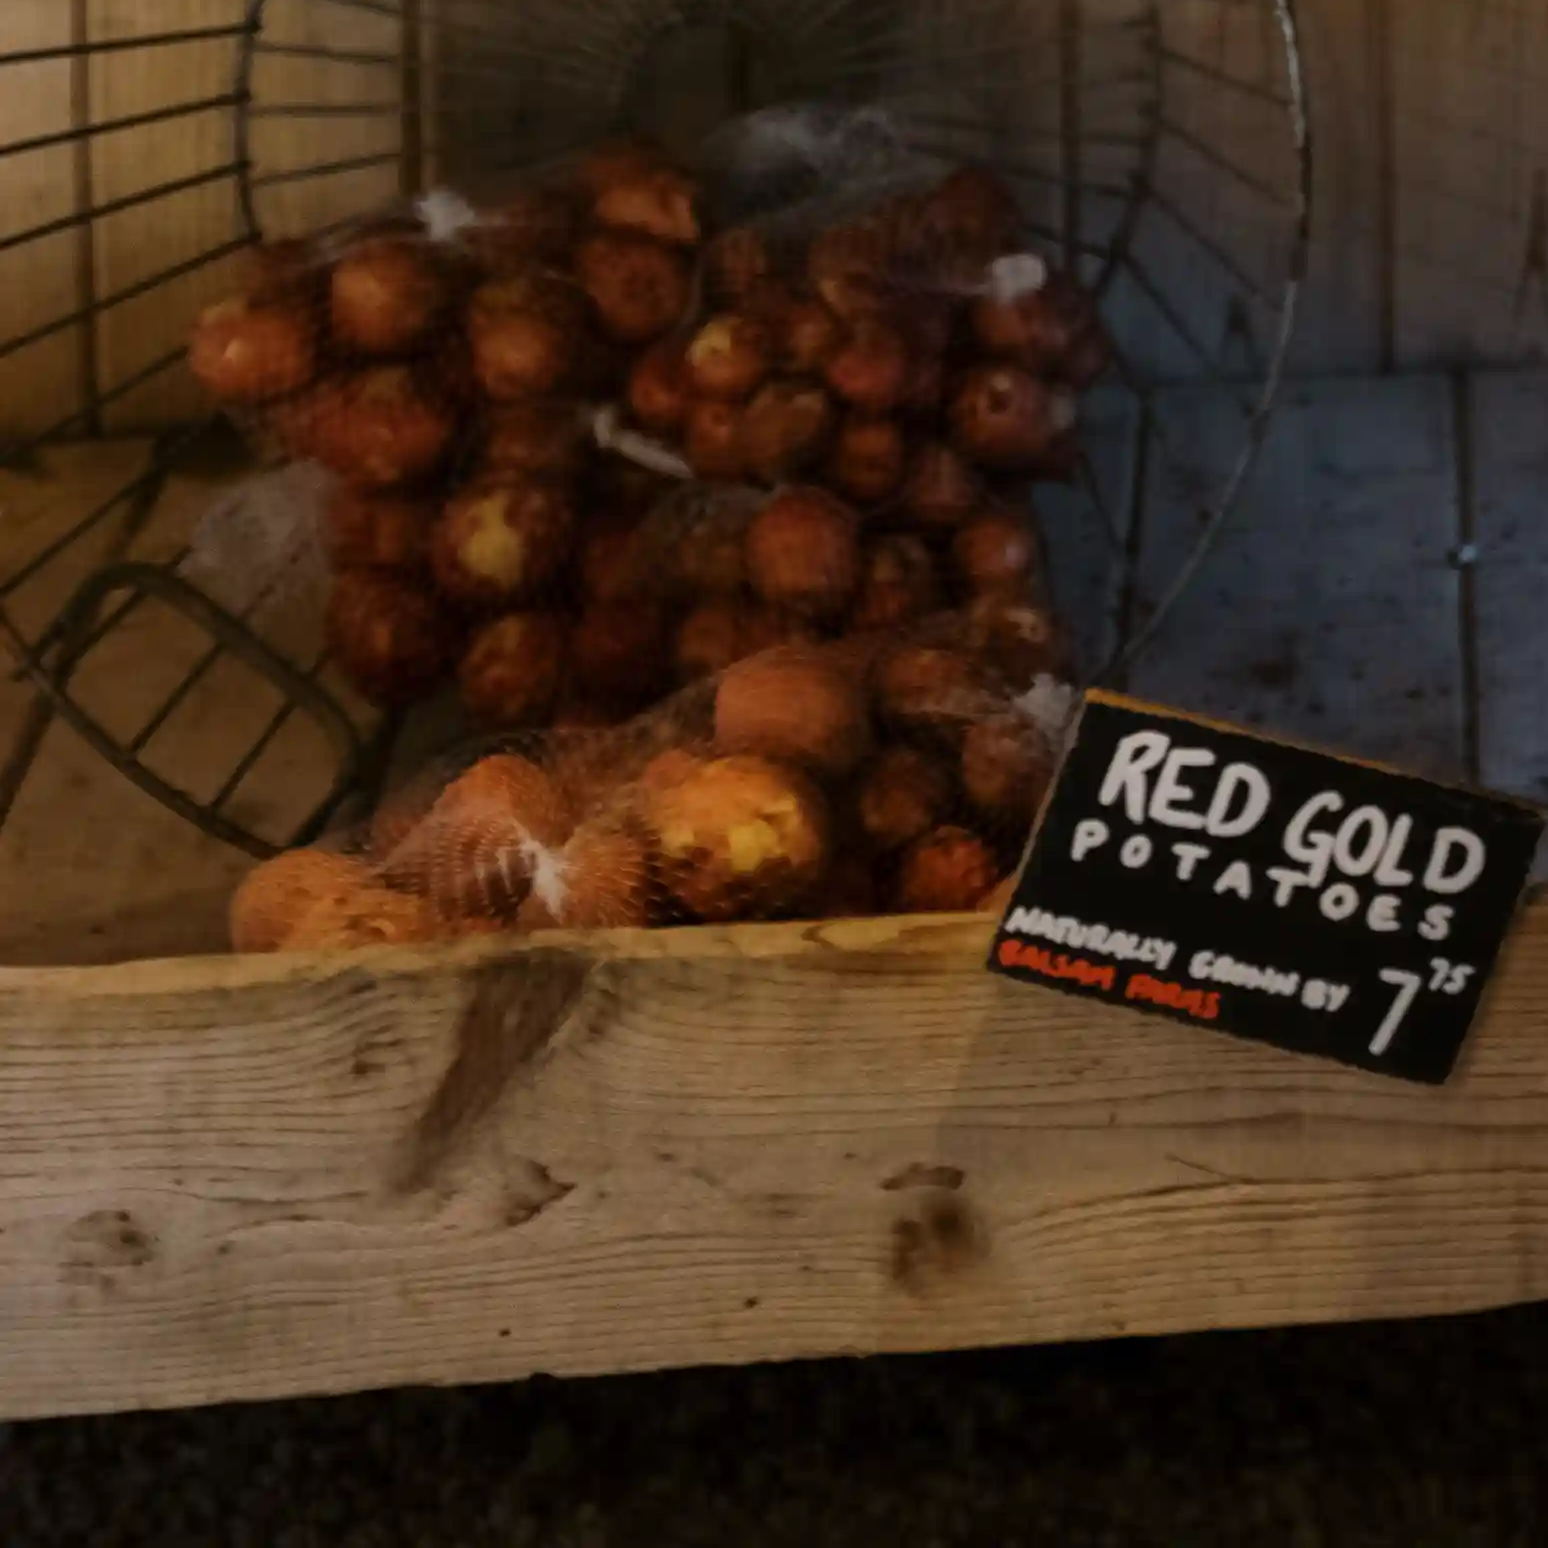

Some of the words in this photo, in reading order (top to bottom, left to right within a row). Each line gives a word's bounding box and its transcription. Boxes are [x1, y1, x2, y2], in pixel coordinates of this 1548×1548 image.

[1071, 819, 1456, 941] POTATOES
[1099, 730, 1272, 840] RED
[1282, 790, 1486, 896] GOLD
